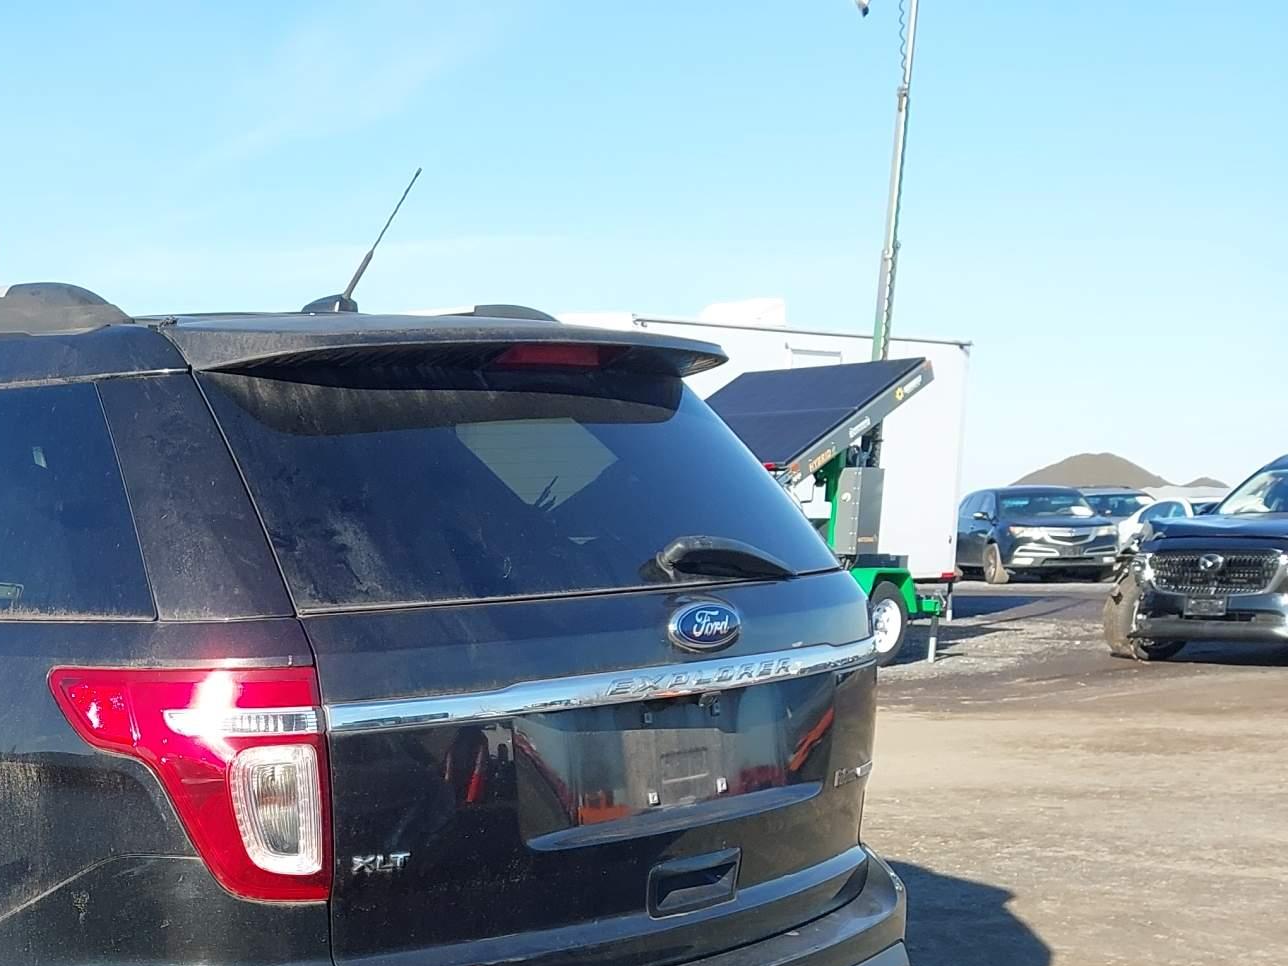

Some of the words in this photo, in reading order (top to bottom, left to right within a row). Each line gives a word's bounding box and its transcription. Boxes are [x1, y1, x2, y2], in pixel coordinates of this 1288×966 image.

[692, 609, 730, 638] Ford
[606, 657, 793, 697] EXPLORER
[351, 852, 412, 874] XLT
